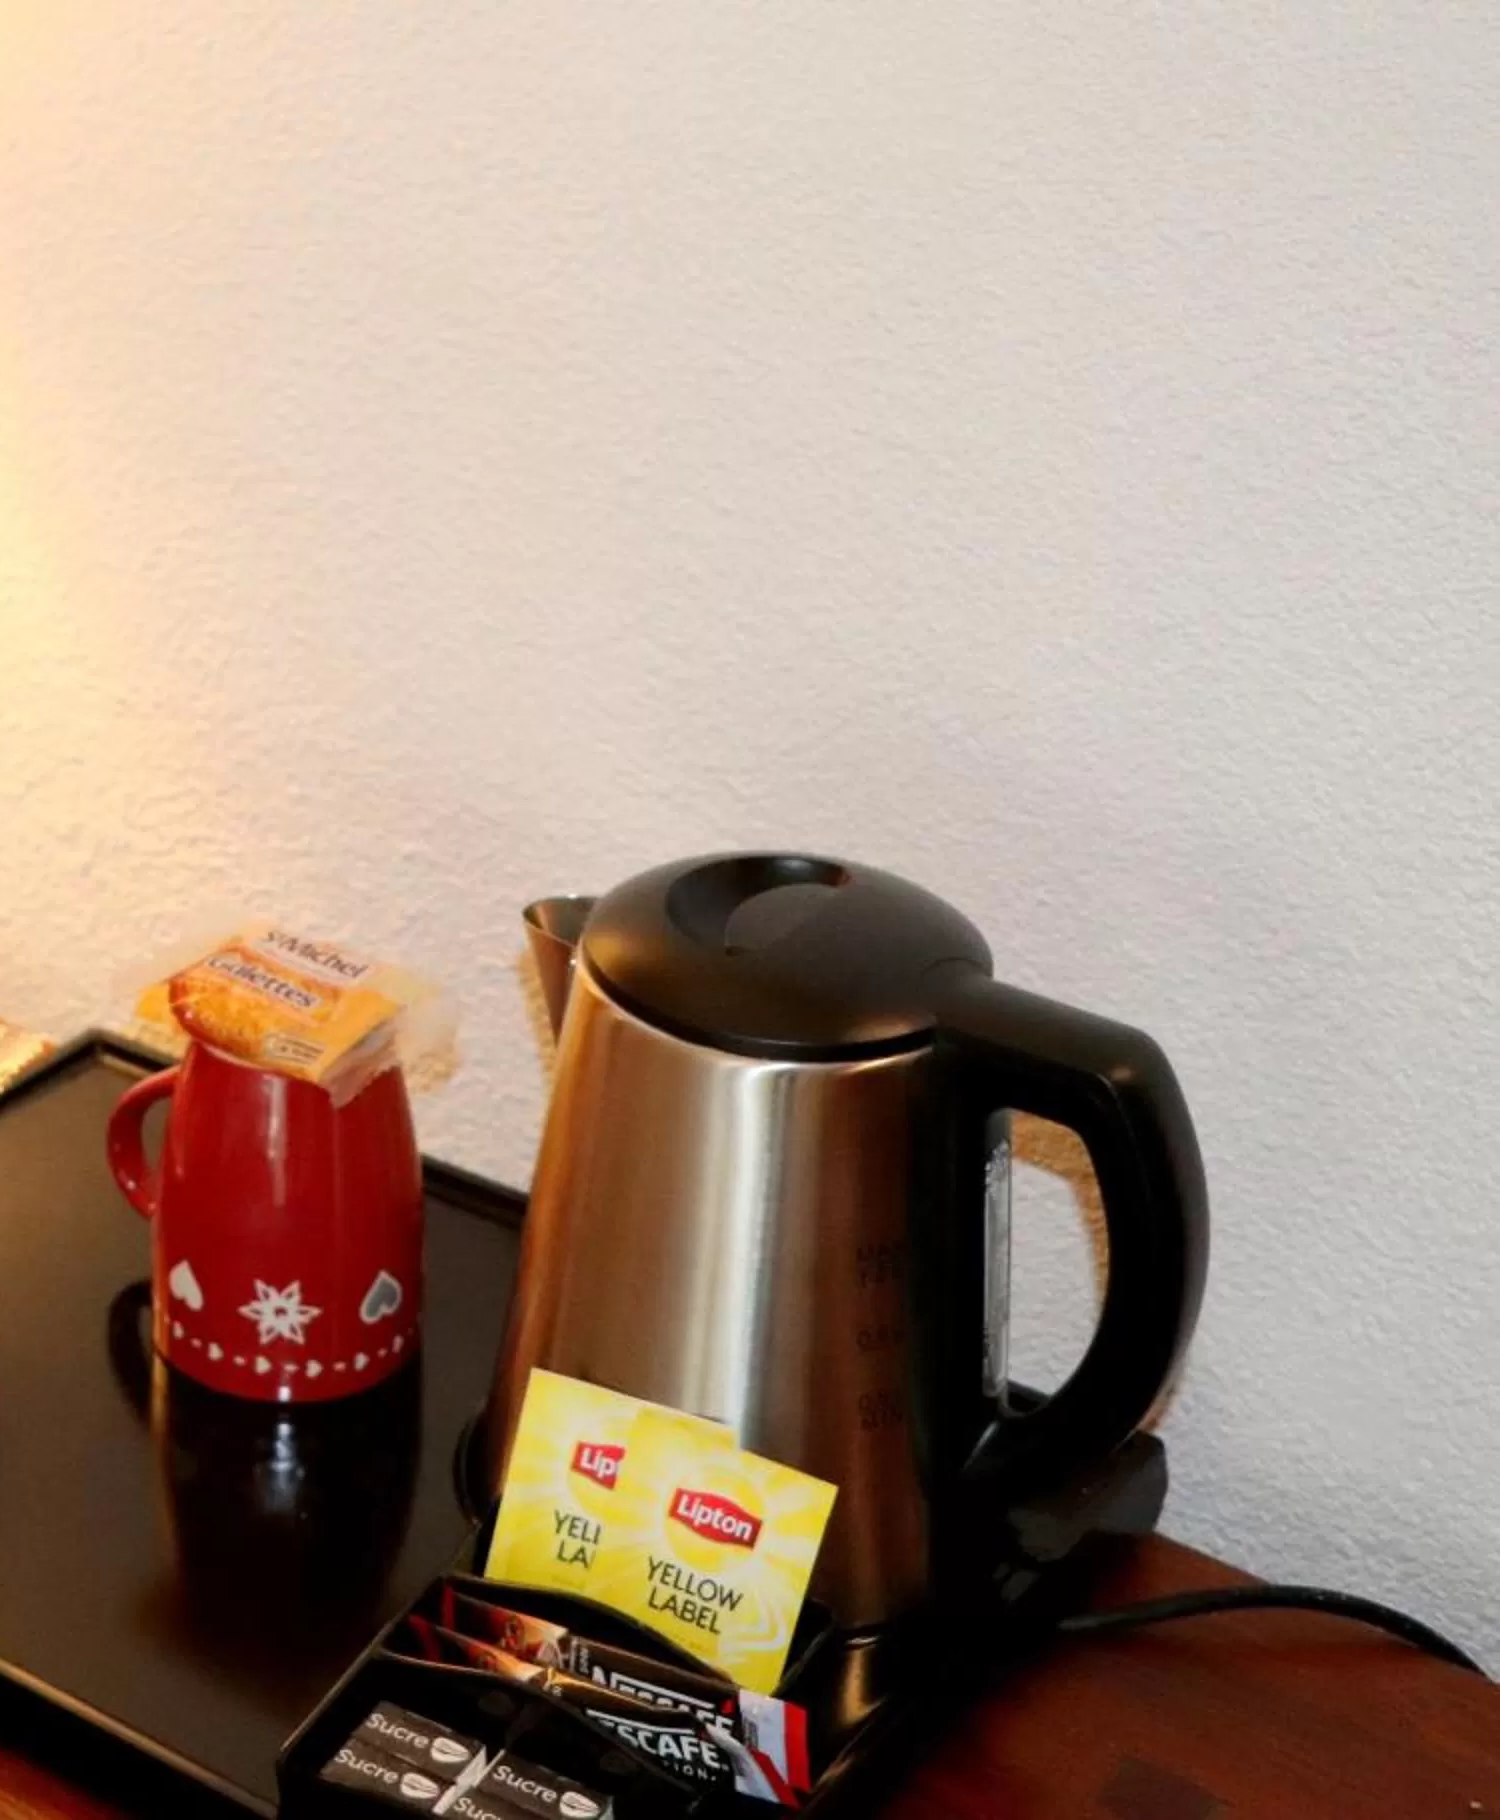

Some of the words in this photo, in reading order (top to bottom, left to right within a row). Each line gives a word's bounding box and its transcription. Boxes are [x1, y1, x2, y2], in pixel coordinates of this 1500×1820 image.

[675, 1493, 753, 1541] Lipton
[555, 1540, 597, 1570] LA
[647, 1555, 744, 1612] YELLOW
[647, 1587, 721, 1636] LABEL
[364, 1711, 430, 1750] Sucre
[333, 1747, 400, 1785] Sucre
[492, 1764, 558, 1802] Sucre
